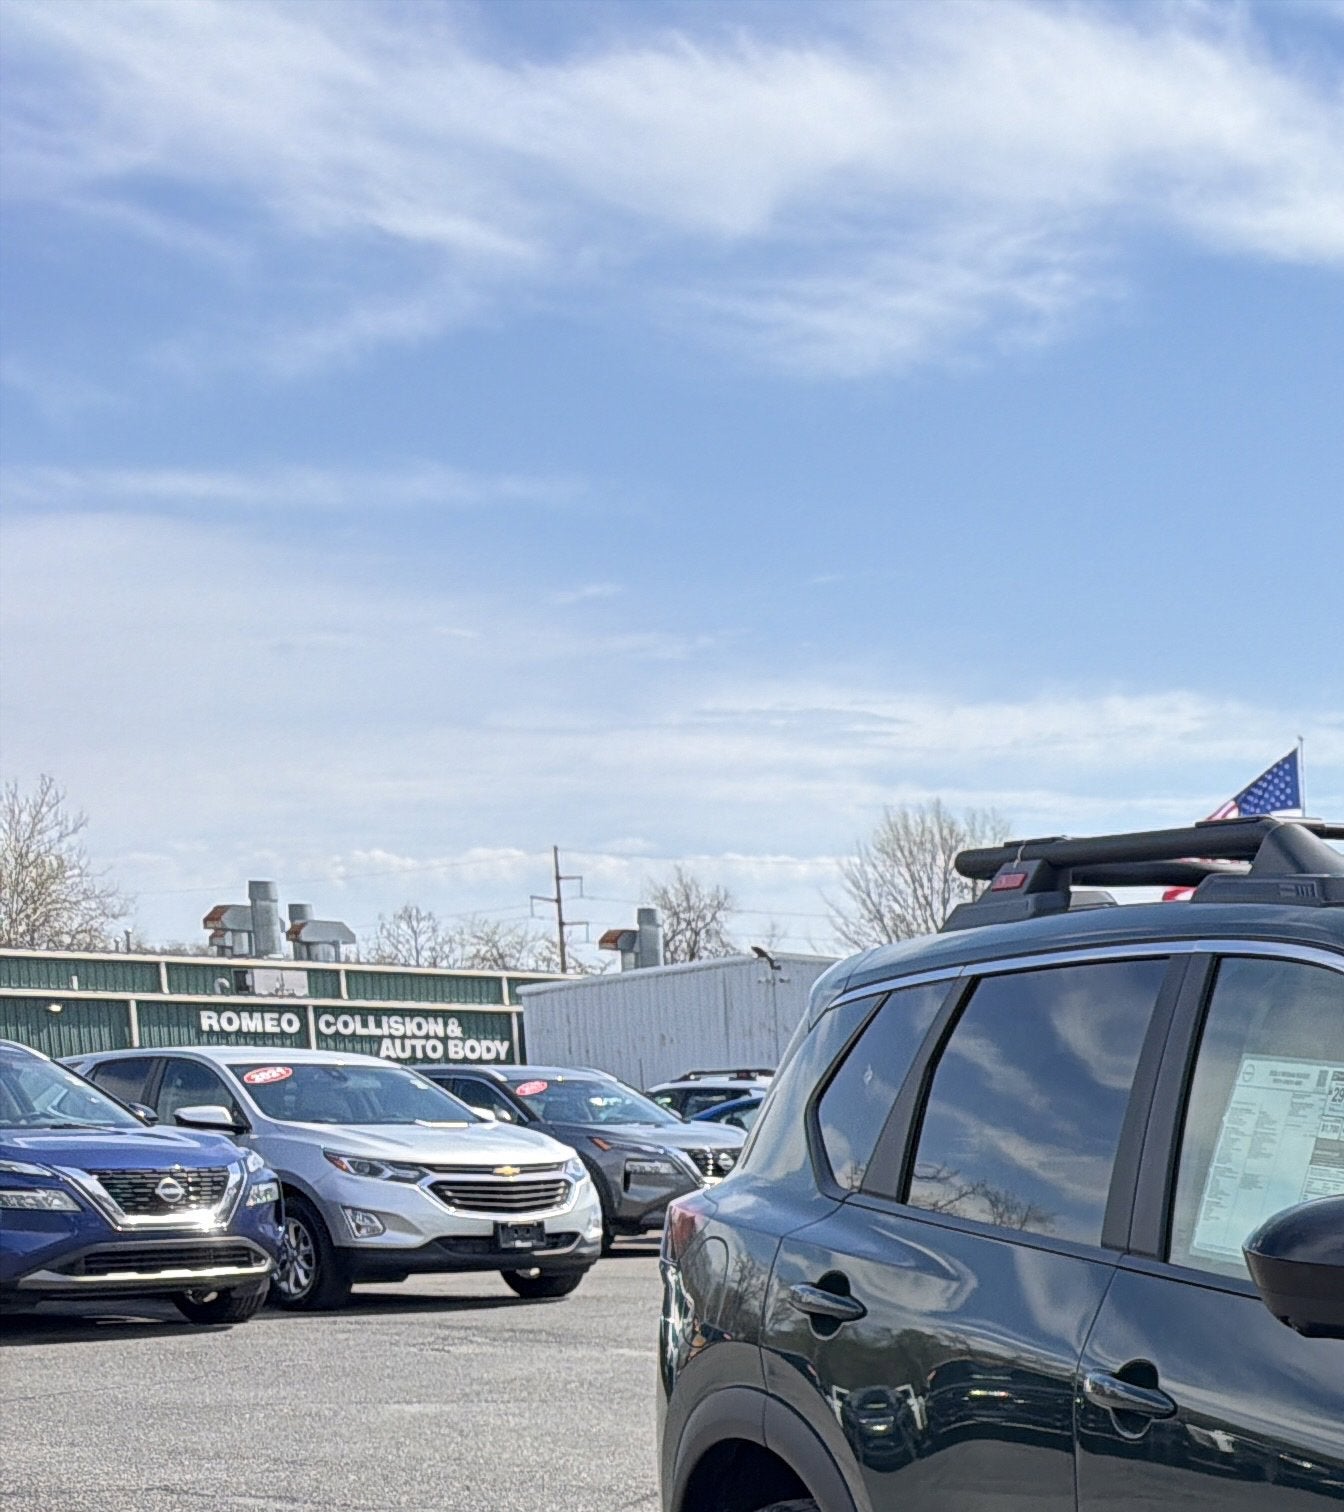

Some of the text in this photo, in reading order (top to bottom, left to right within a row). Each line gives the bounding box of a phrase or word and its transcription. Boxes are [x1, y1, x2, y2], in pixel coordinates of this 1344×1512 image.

[200, 1010, 300, 1033] ROMEO
[318, 1014, 463, 1037] COLLISION &
[379, 1038, 510, 1061] AUTO BODY
